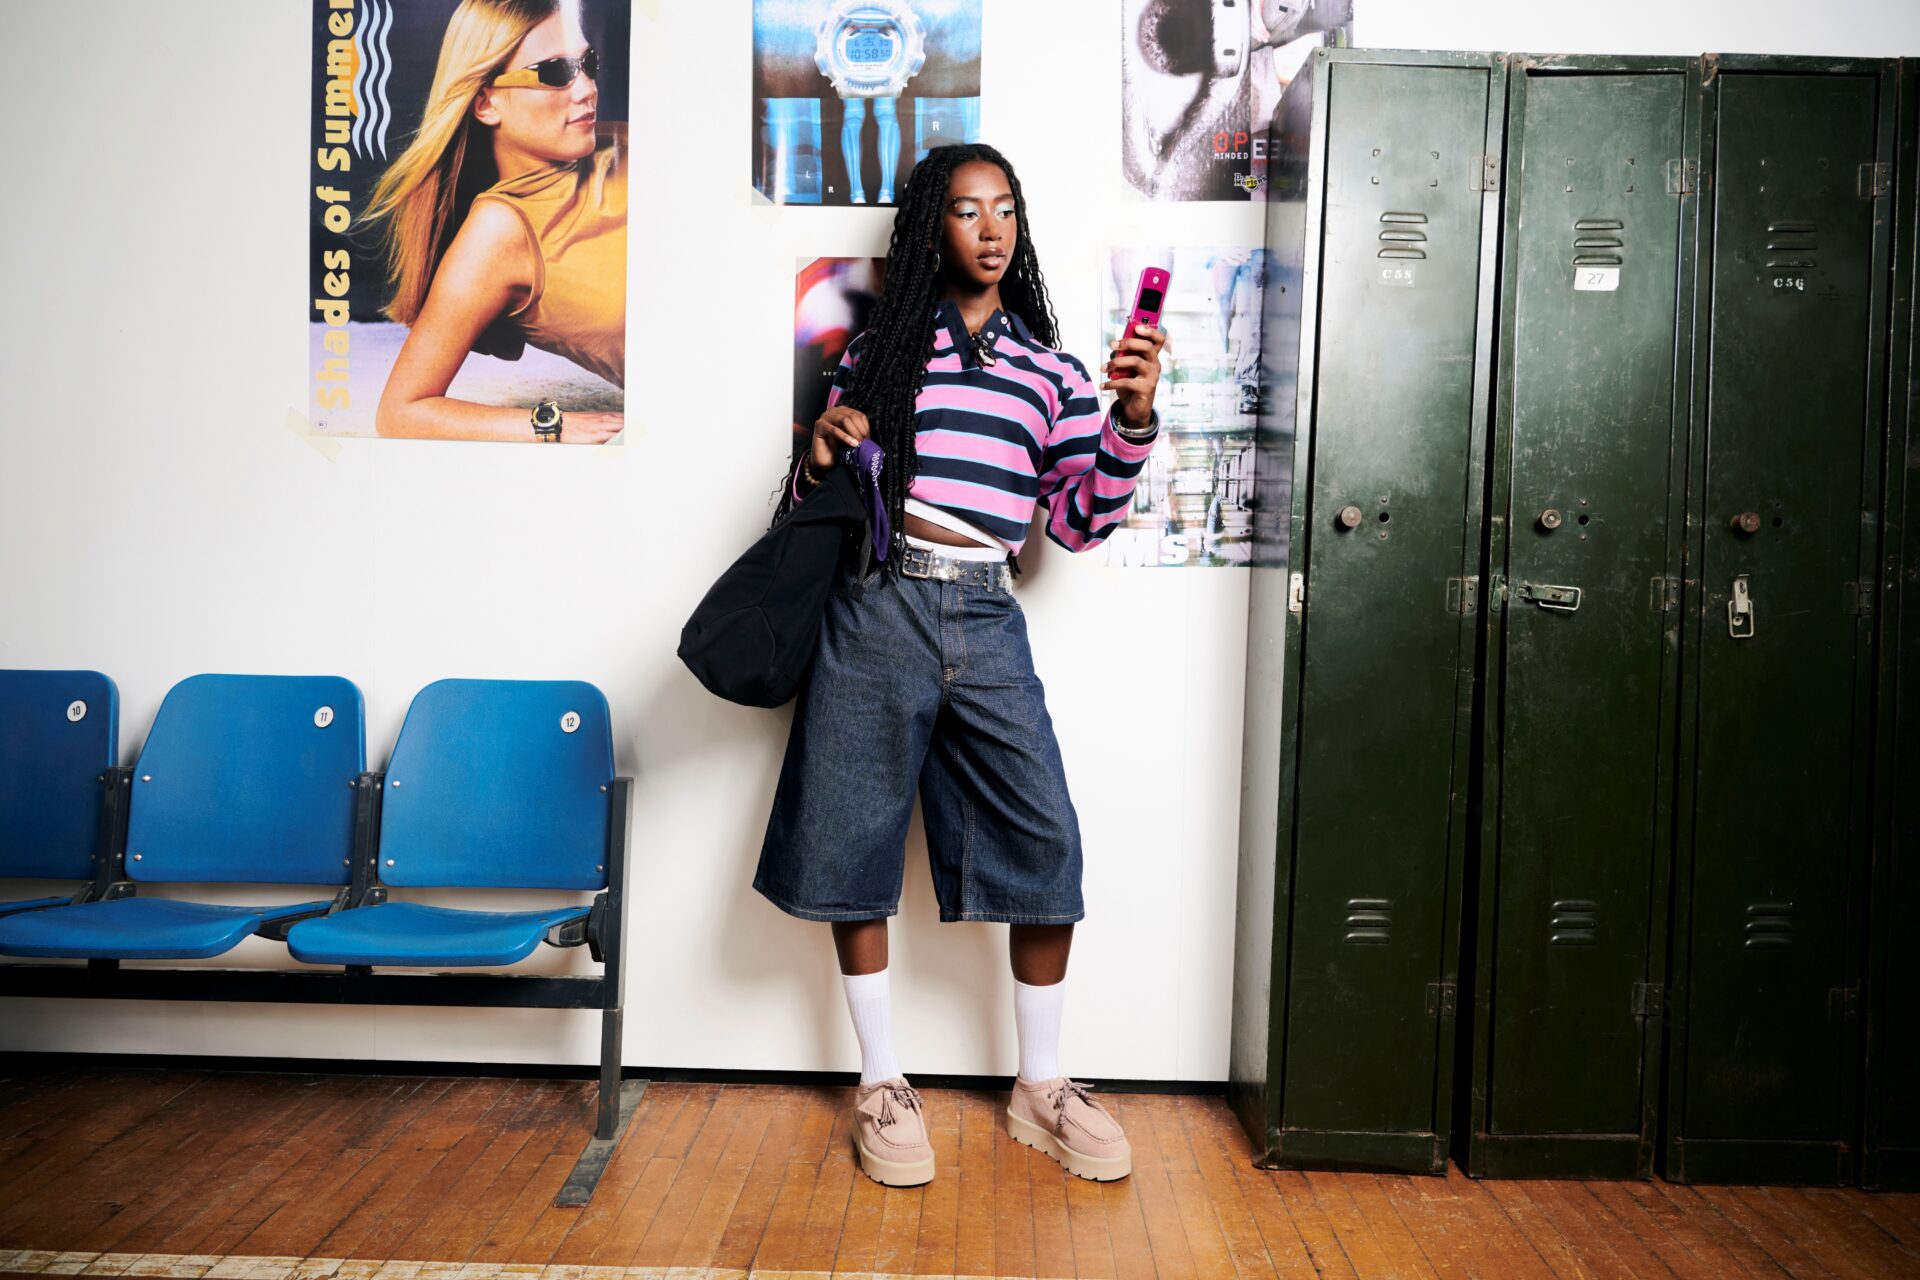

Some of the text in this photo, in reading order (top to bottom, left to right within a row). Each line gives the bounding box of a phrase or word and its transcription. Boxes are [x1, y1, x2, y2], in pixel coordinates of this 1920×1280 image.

[932, 121, 940, 131] R
[1214, 152, 1249, 160] MINDED
[315, 186, 351, 233] of
[1588, 272, 1605, 285] 27
[315, 249, 350, 410] Shades
[72, 705, 81, 717] 10
[320, 711, 328, 722] 11
[566, 717, 575, 728] 12
